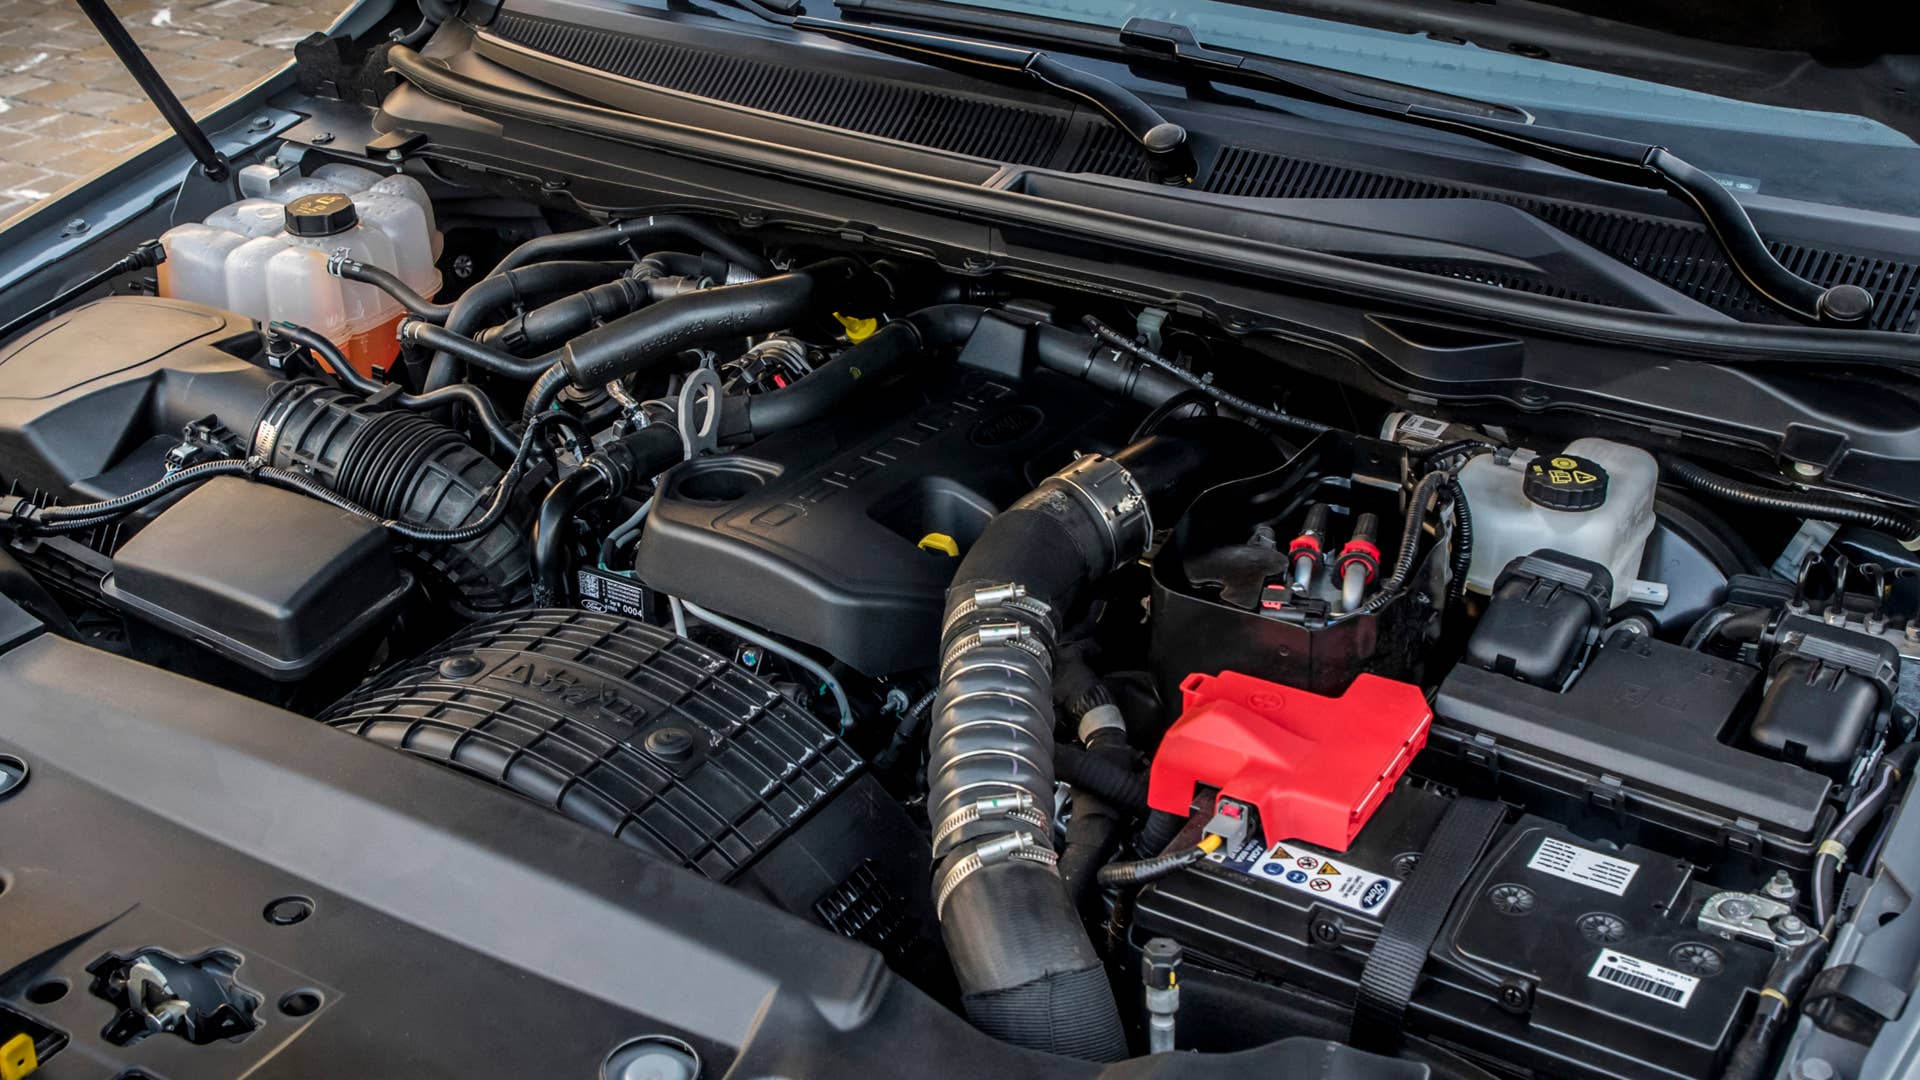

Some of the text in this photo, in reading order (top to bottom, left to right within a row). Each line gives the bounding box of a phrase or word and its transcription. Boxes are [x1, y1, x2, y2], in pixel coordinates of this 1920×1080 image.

[583, 600, 605, 613] Ford
[622, 604, 643, 617] 0004
[1362, 881, 1388, 907] Ford
